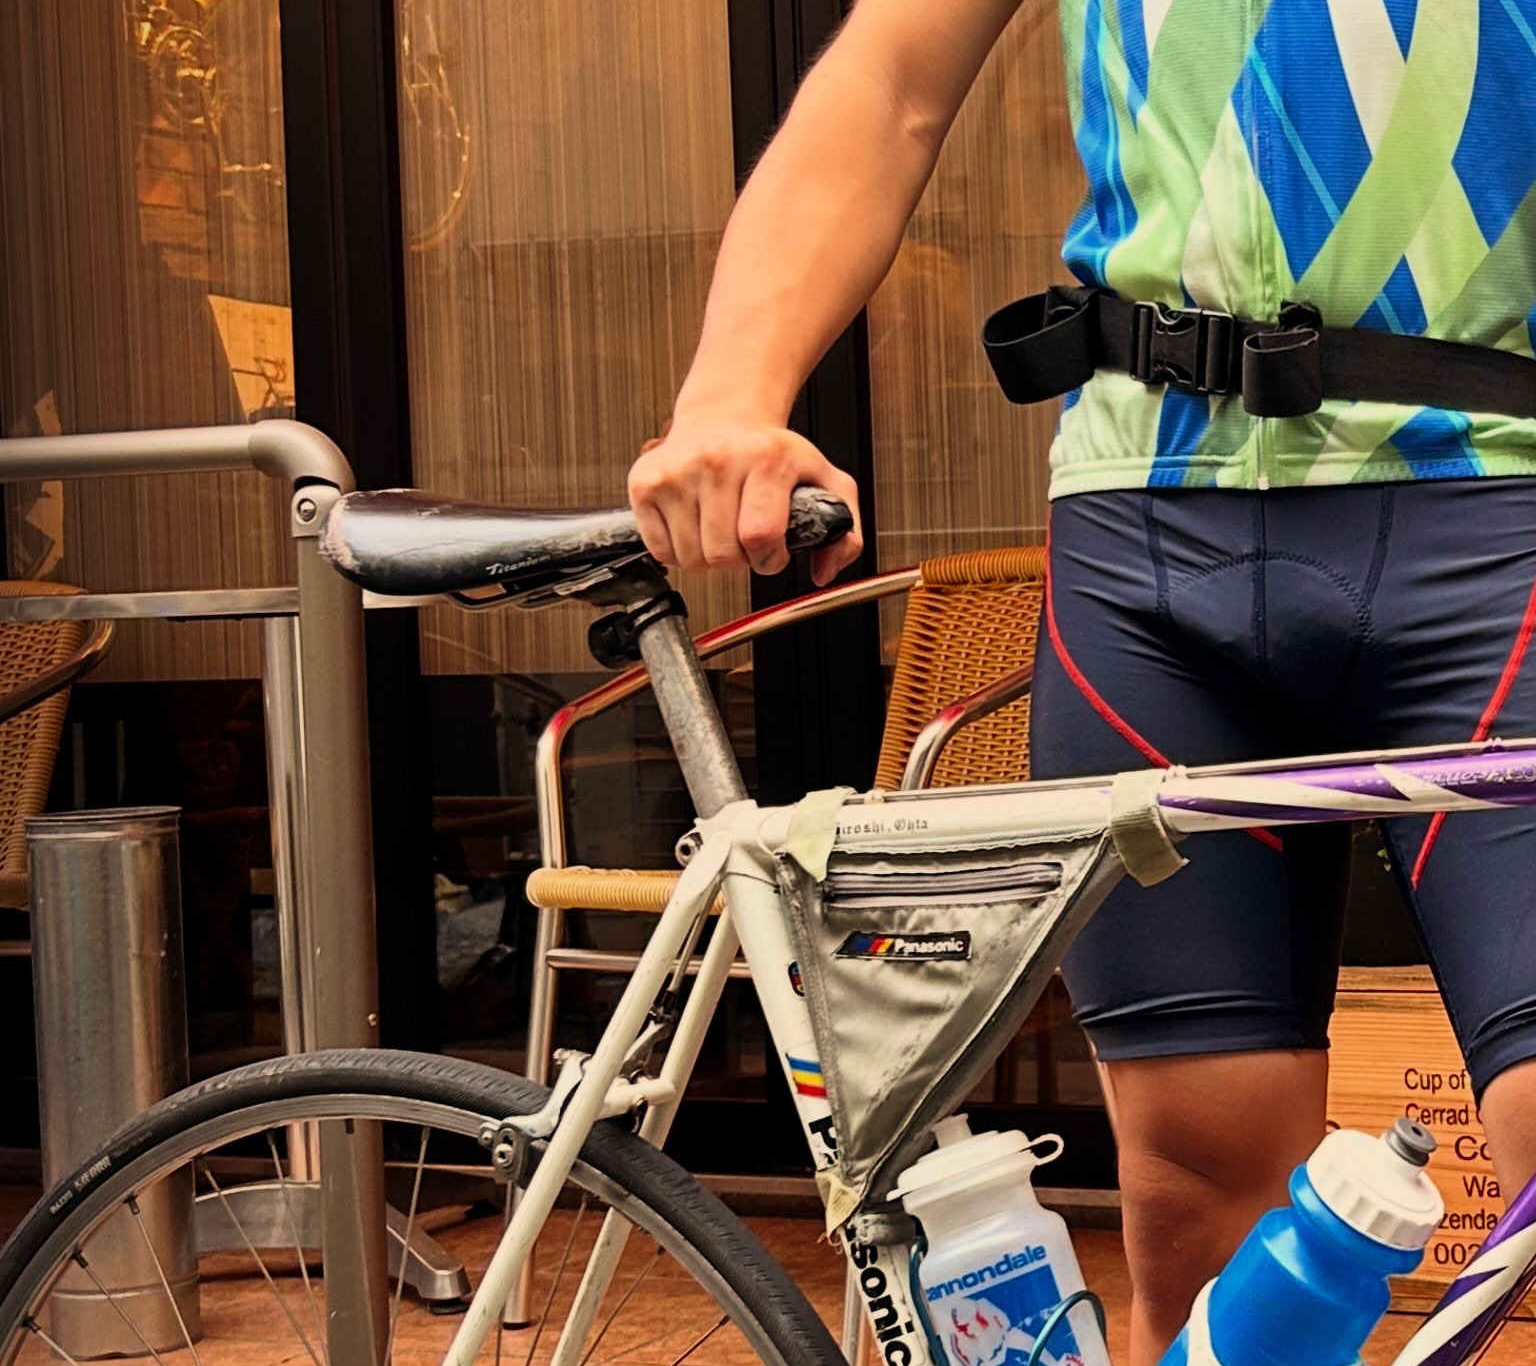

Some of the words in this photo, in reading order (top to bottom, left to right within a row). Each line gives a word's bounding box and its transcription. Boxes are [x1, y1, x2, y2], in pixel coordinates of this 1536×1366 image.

[893, 937, 965, 957] Panasonic
[1404, 1067, 1443, 1095] Cup
[1448, 1068, 1467, 1090] of
[924, 1244, 1047, 1302] annondale
